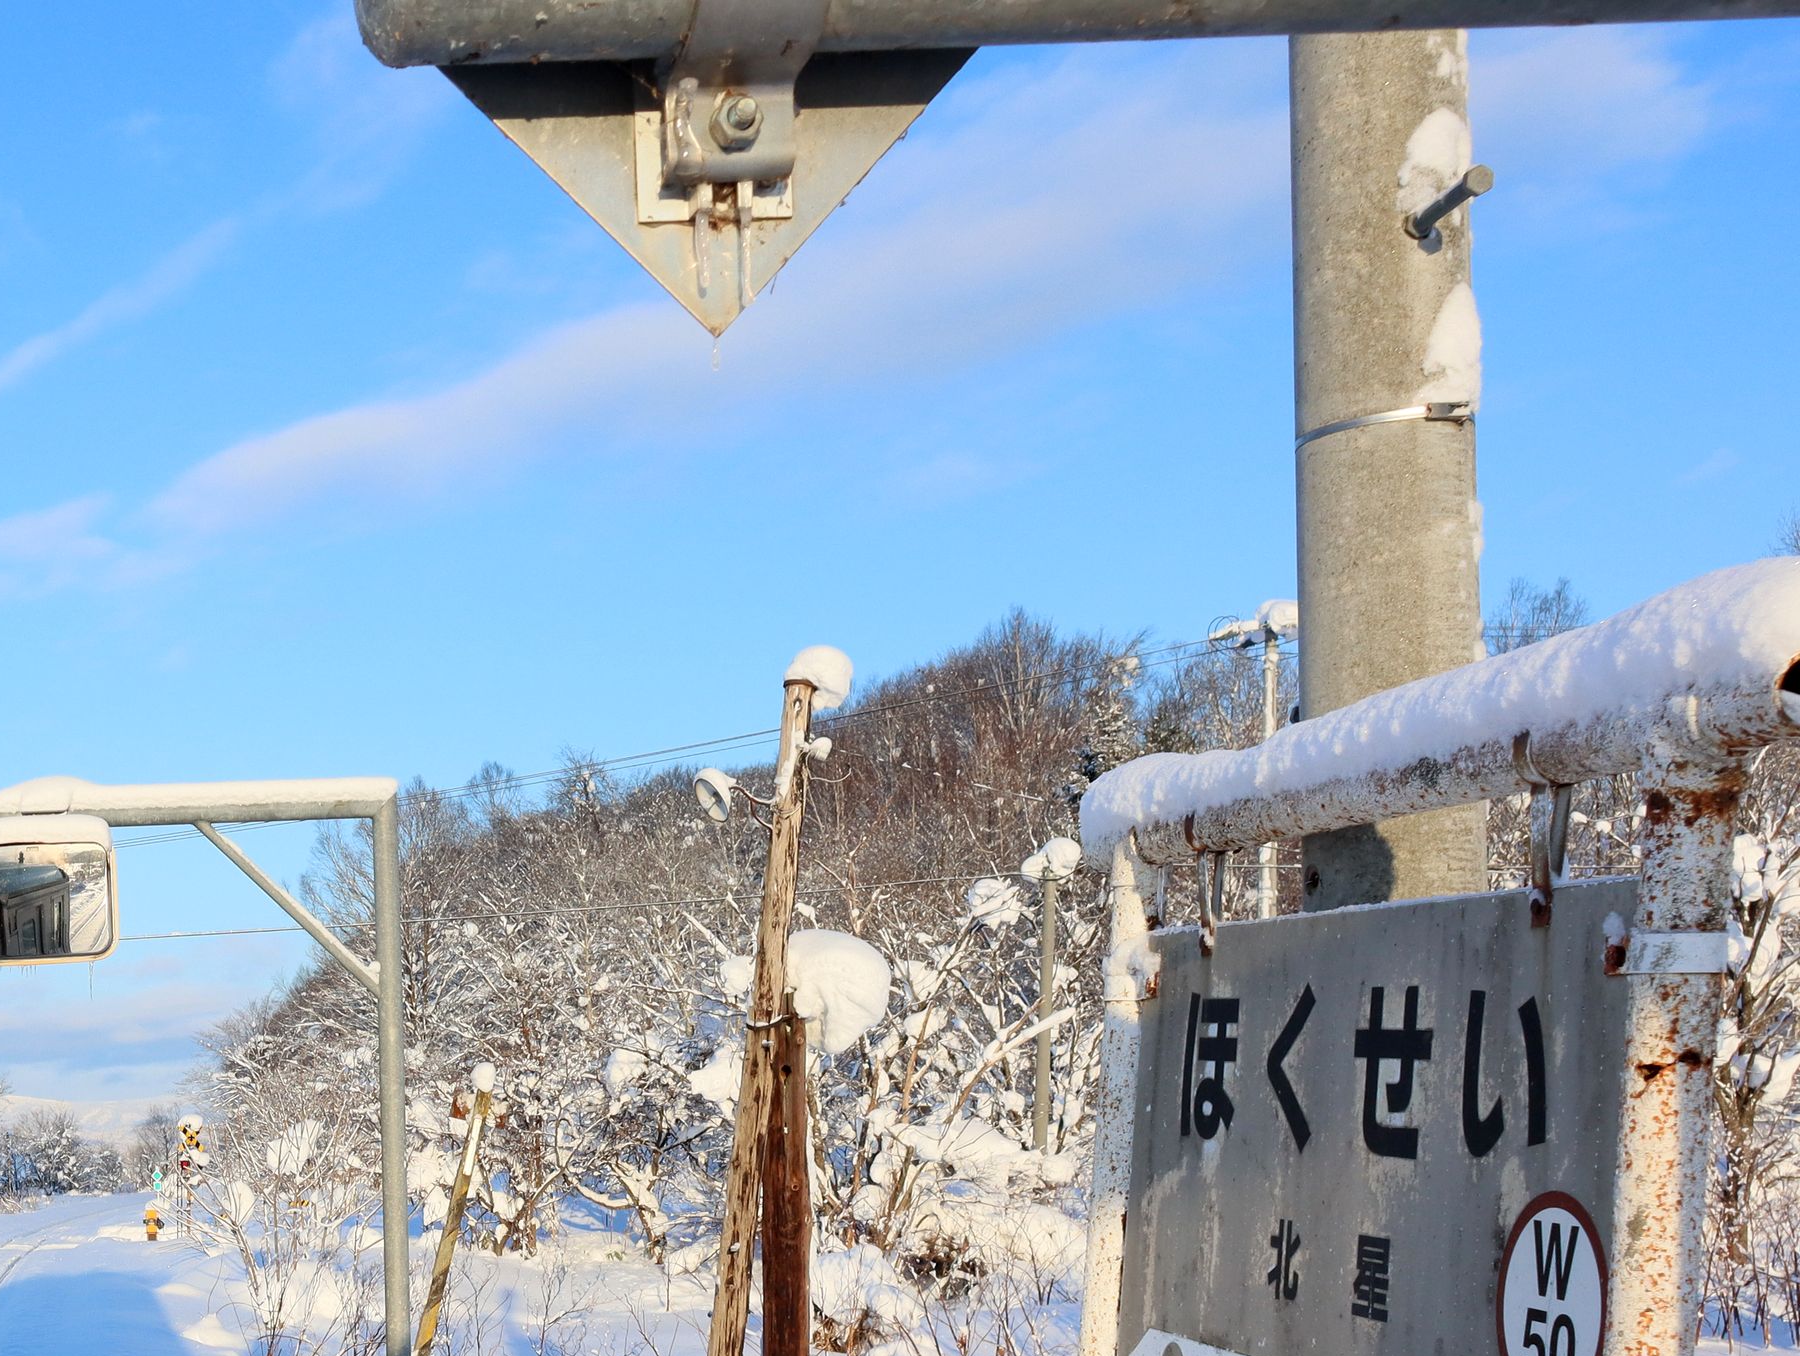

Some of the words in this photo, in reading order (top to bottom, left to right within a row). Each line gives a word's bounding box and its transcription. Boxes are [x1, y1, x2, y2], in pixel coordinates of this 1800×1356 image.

[1181, 982, 1547, 1160] ほくせい
[1267, 1218, 1391, 1323] 北星
[1532, 1219, 1580, 1301] W
